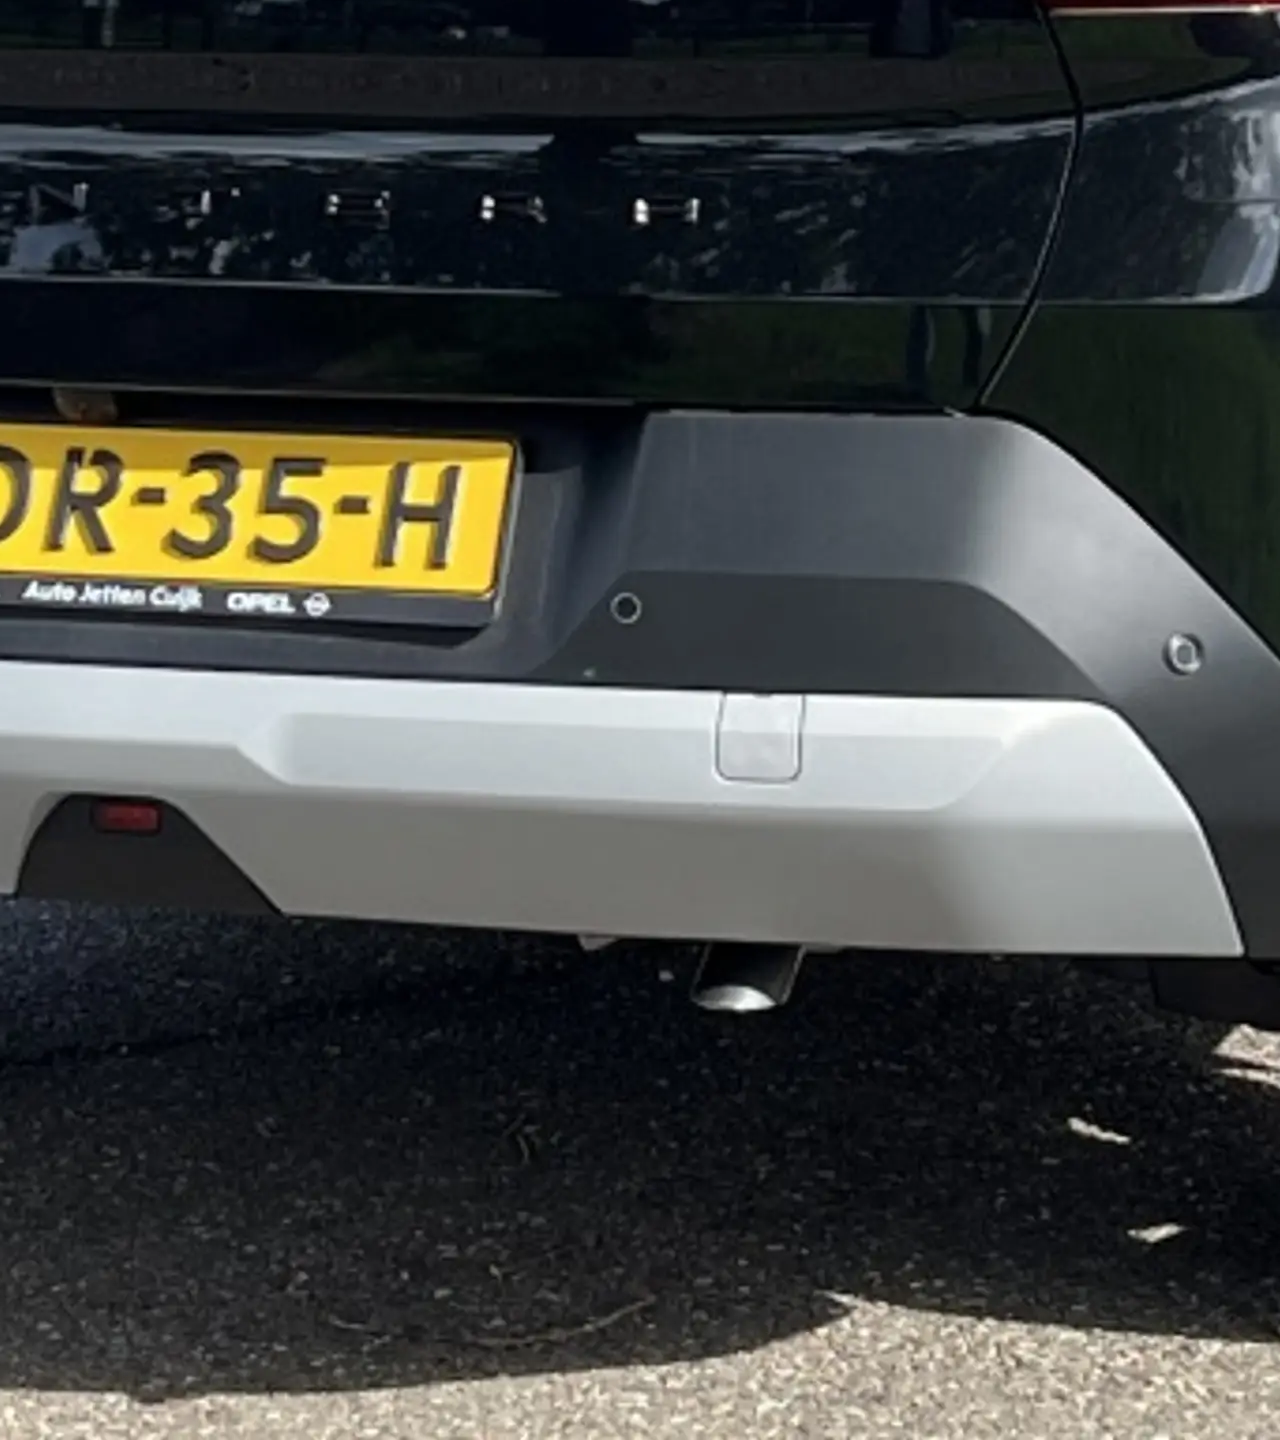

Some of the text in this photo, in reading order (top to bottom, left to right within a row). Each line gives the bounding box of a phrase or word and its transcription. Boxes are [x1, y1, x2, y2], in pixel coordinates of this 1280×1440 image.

[22, 580, 77, 603] Auto
[79, 582, 145, 607] Jetten
[227, 591, 296, 614] OPEL
